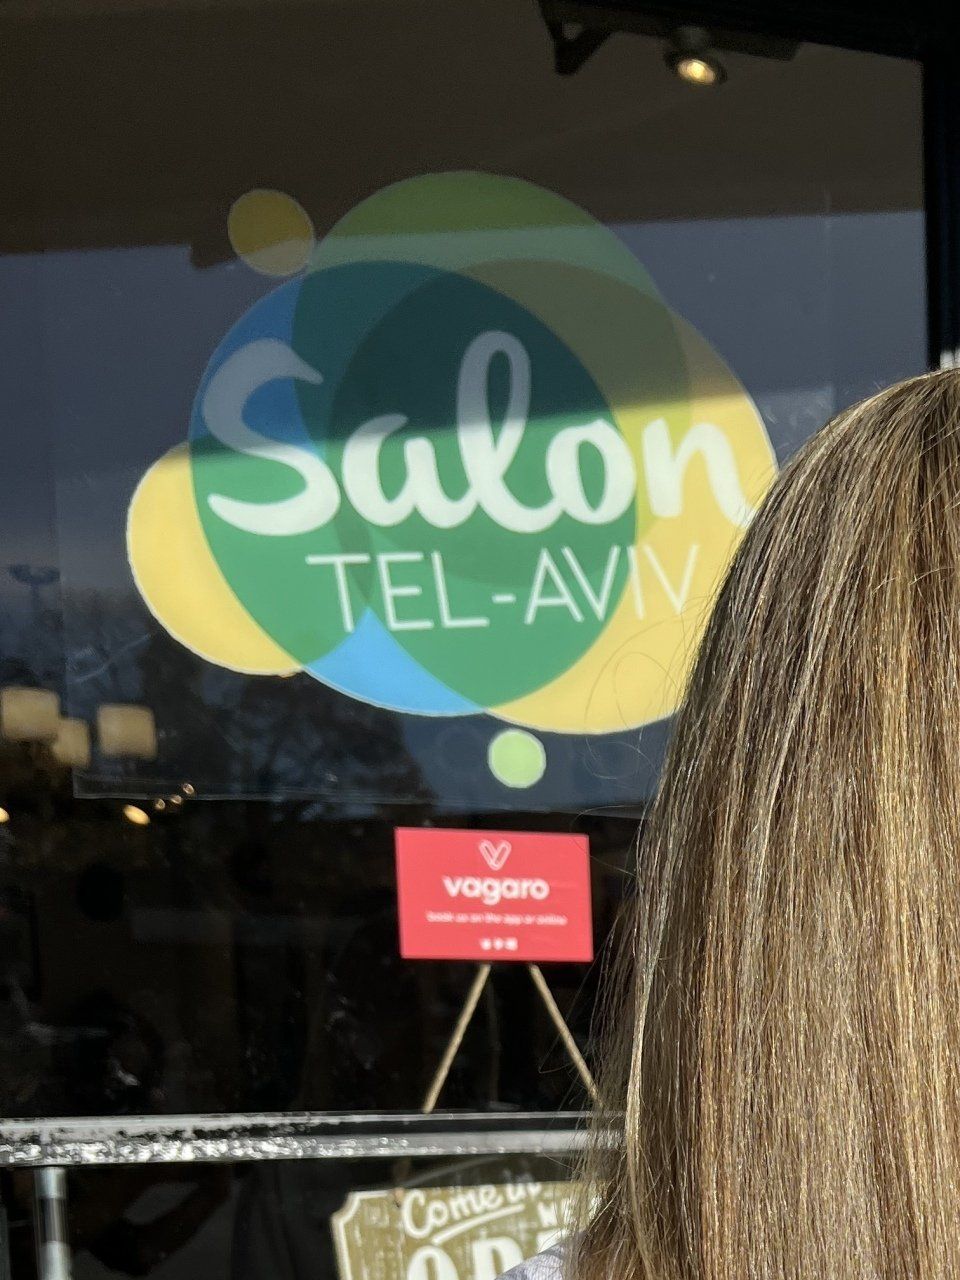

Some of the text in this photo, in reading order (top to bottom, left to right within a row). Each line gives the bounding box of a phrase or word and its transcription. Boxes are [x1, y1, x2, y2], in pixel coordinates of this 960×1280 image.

[203, 330, 755, 537] Salon
[305, 543, 699, 633] TEL-AVIV
[442, 874, 550, 906] vagaro
[402, 1183, 503, 1240] Come
